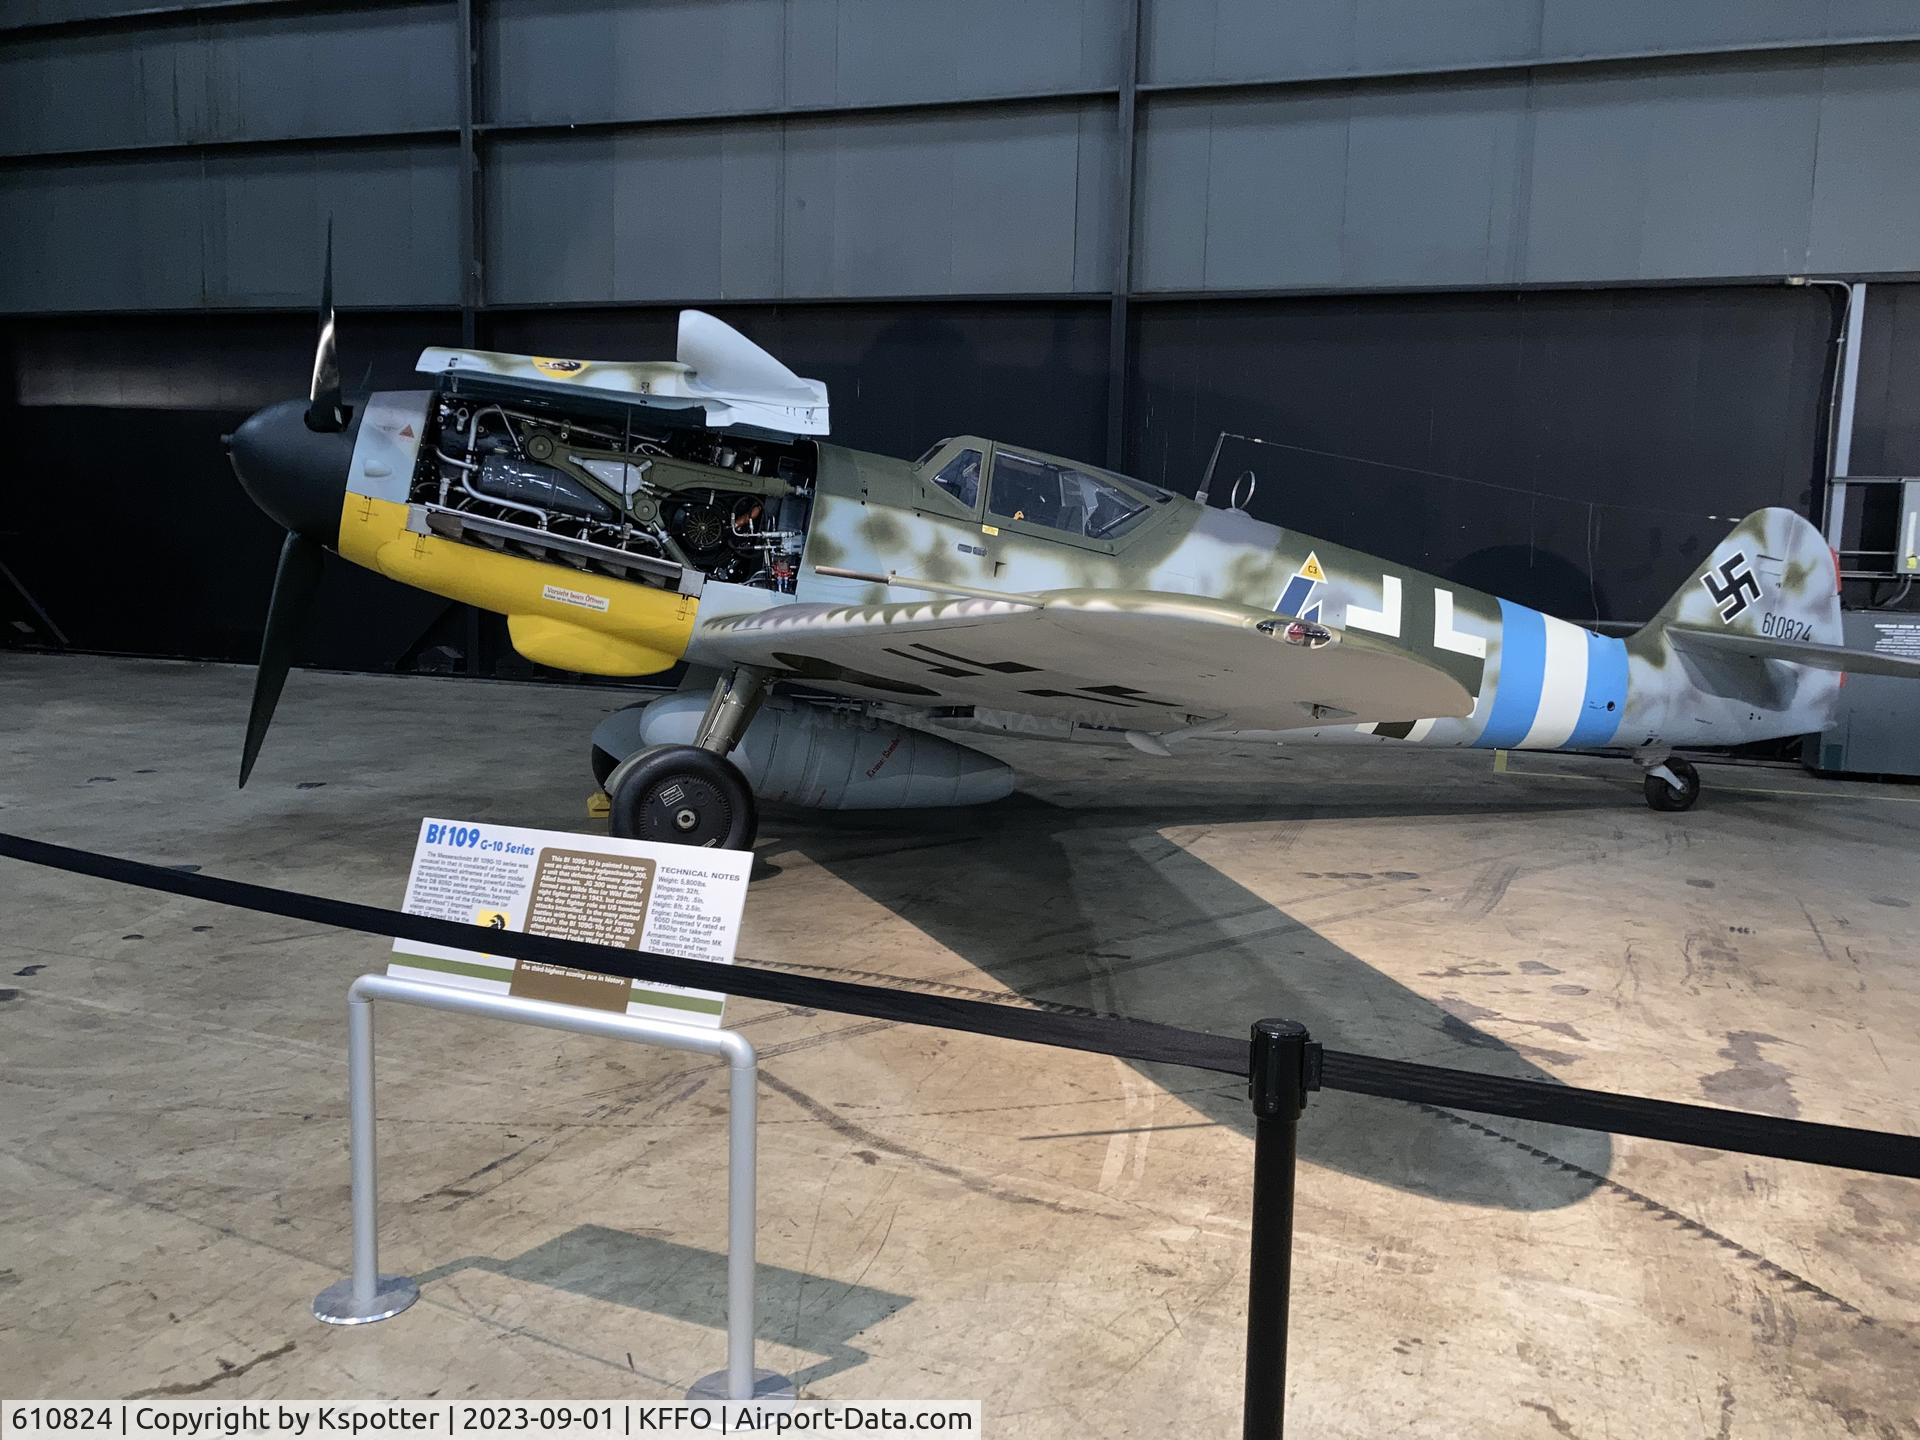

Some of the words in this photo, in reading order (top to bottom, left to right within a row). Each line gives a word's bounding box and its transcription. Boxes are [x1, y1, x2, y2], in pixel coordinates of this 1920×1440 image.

[1308, 565, 1318, 574] C3
[1762, 612, 1812, 642] 610824
[480, 840, 503, 852] G-10
[505, 842, 535, 856] Series
[661, 867, 708, 877] TECHNICAL
[711, 873, 740, 881] NOTES
